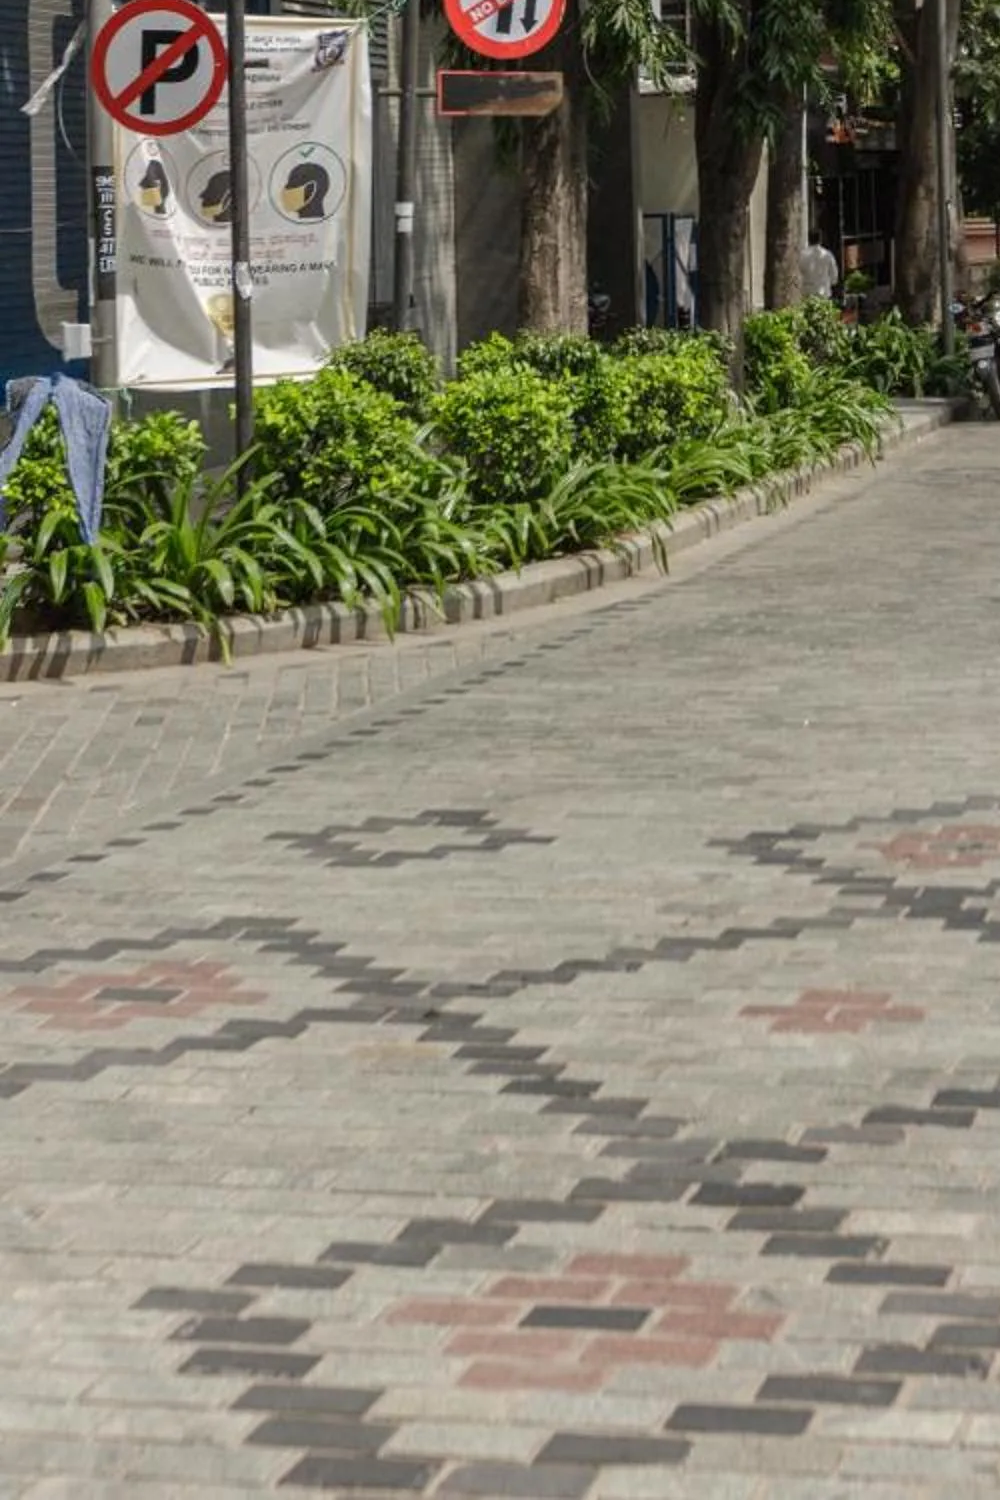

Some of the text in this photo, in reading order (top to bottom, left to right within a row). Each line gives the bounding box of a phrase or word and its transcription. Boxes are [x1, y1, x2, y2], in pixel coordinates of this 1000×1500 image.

[469, 0, 494, 22] NO
[139, 29, 199, 115] P
[202, 265, 221, 275] FOR
[250, 263, 298, 275] WEARING
